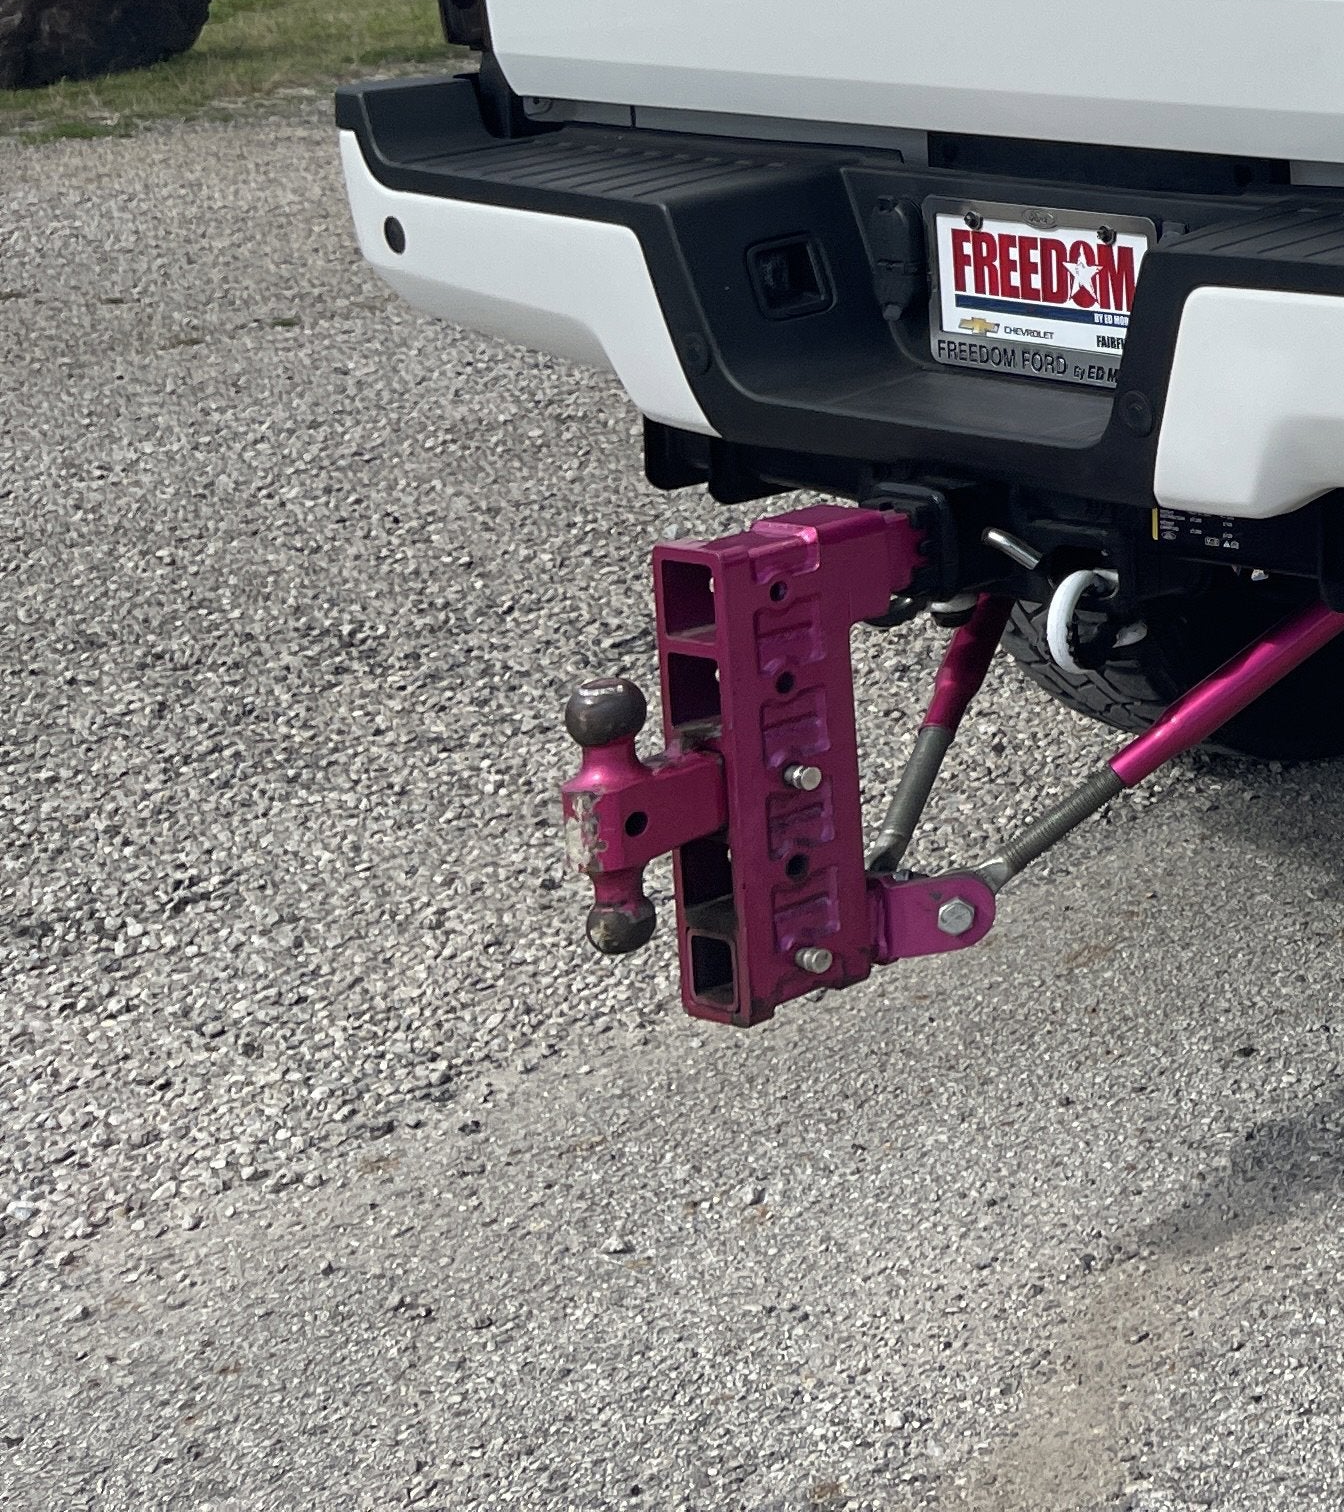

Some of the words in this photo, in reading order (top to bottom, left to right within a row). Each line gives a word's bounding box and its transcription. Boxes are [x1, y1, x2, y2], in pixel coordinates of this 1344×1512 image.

[951, 228, 1136, 312] FREEDOM
[1004, 325, 1055, 340] CHEVROLET
[938, 339, 1016, 368] FREEDOM
[1022, 351, 1068, 375] FORD
[1088, 365, 1105, 380] ED
[1107, 367, 1120, 384] M
